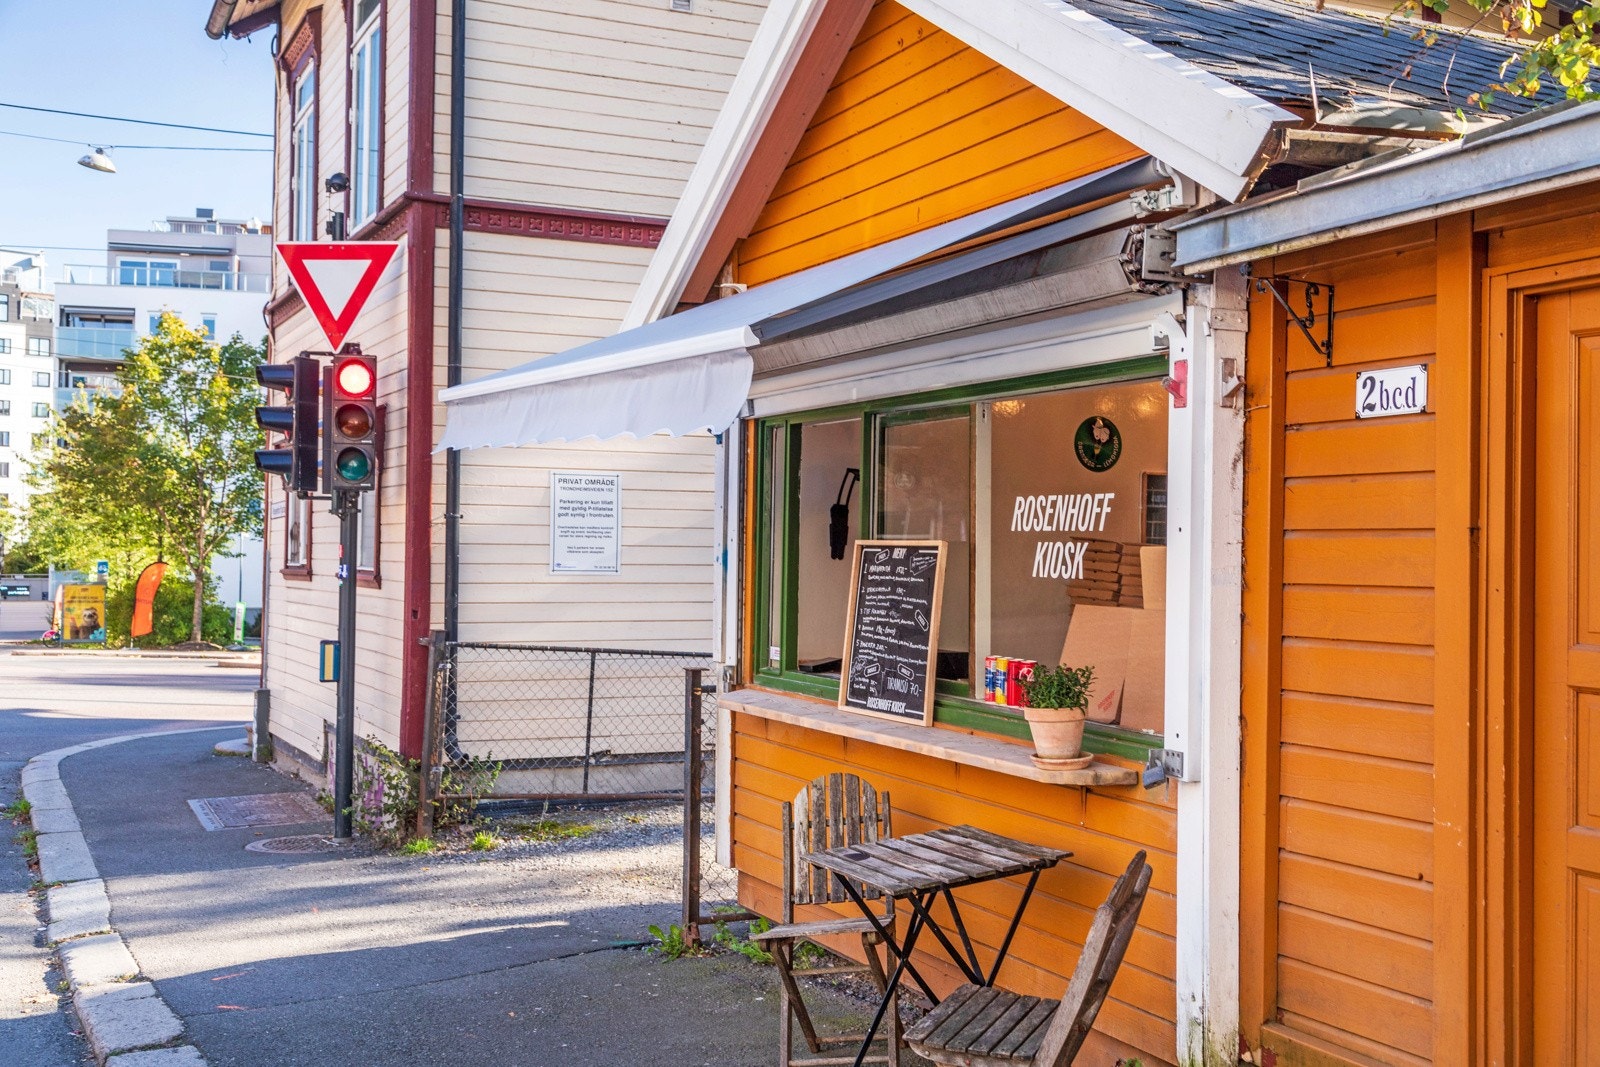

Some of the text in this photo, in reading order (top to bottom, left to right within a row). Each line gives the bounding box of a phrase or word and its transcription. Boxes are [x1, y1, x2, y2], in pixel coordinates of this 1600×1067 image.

[584, 478, 616, 486] OMRÅDE
[1010, 492, 1116, 532] ROSENHOFF
[1032, 541, 1089, 579] KIOSK
[866, 696, 906, 714] ROSENHOFF KIOSK
